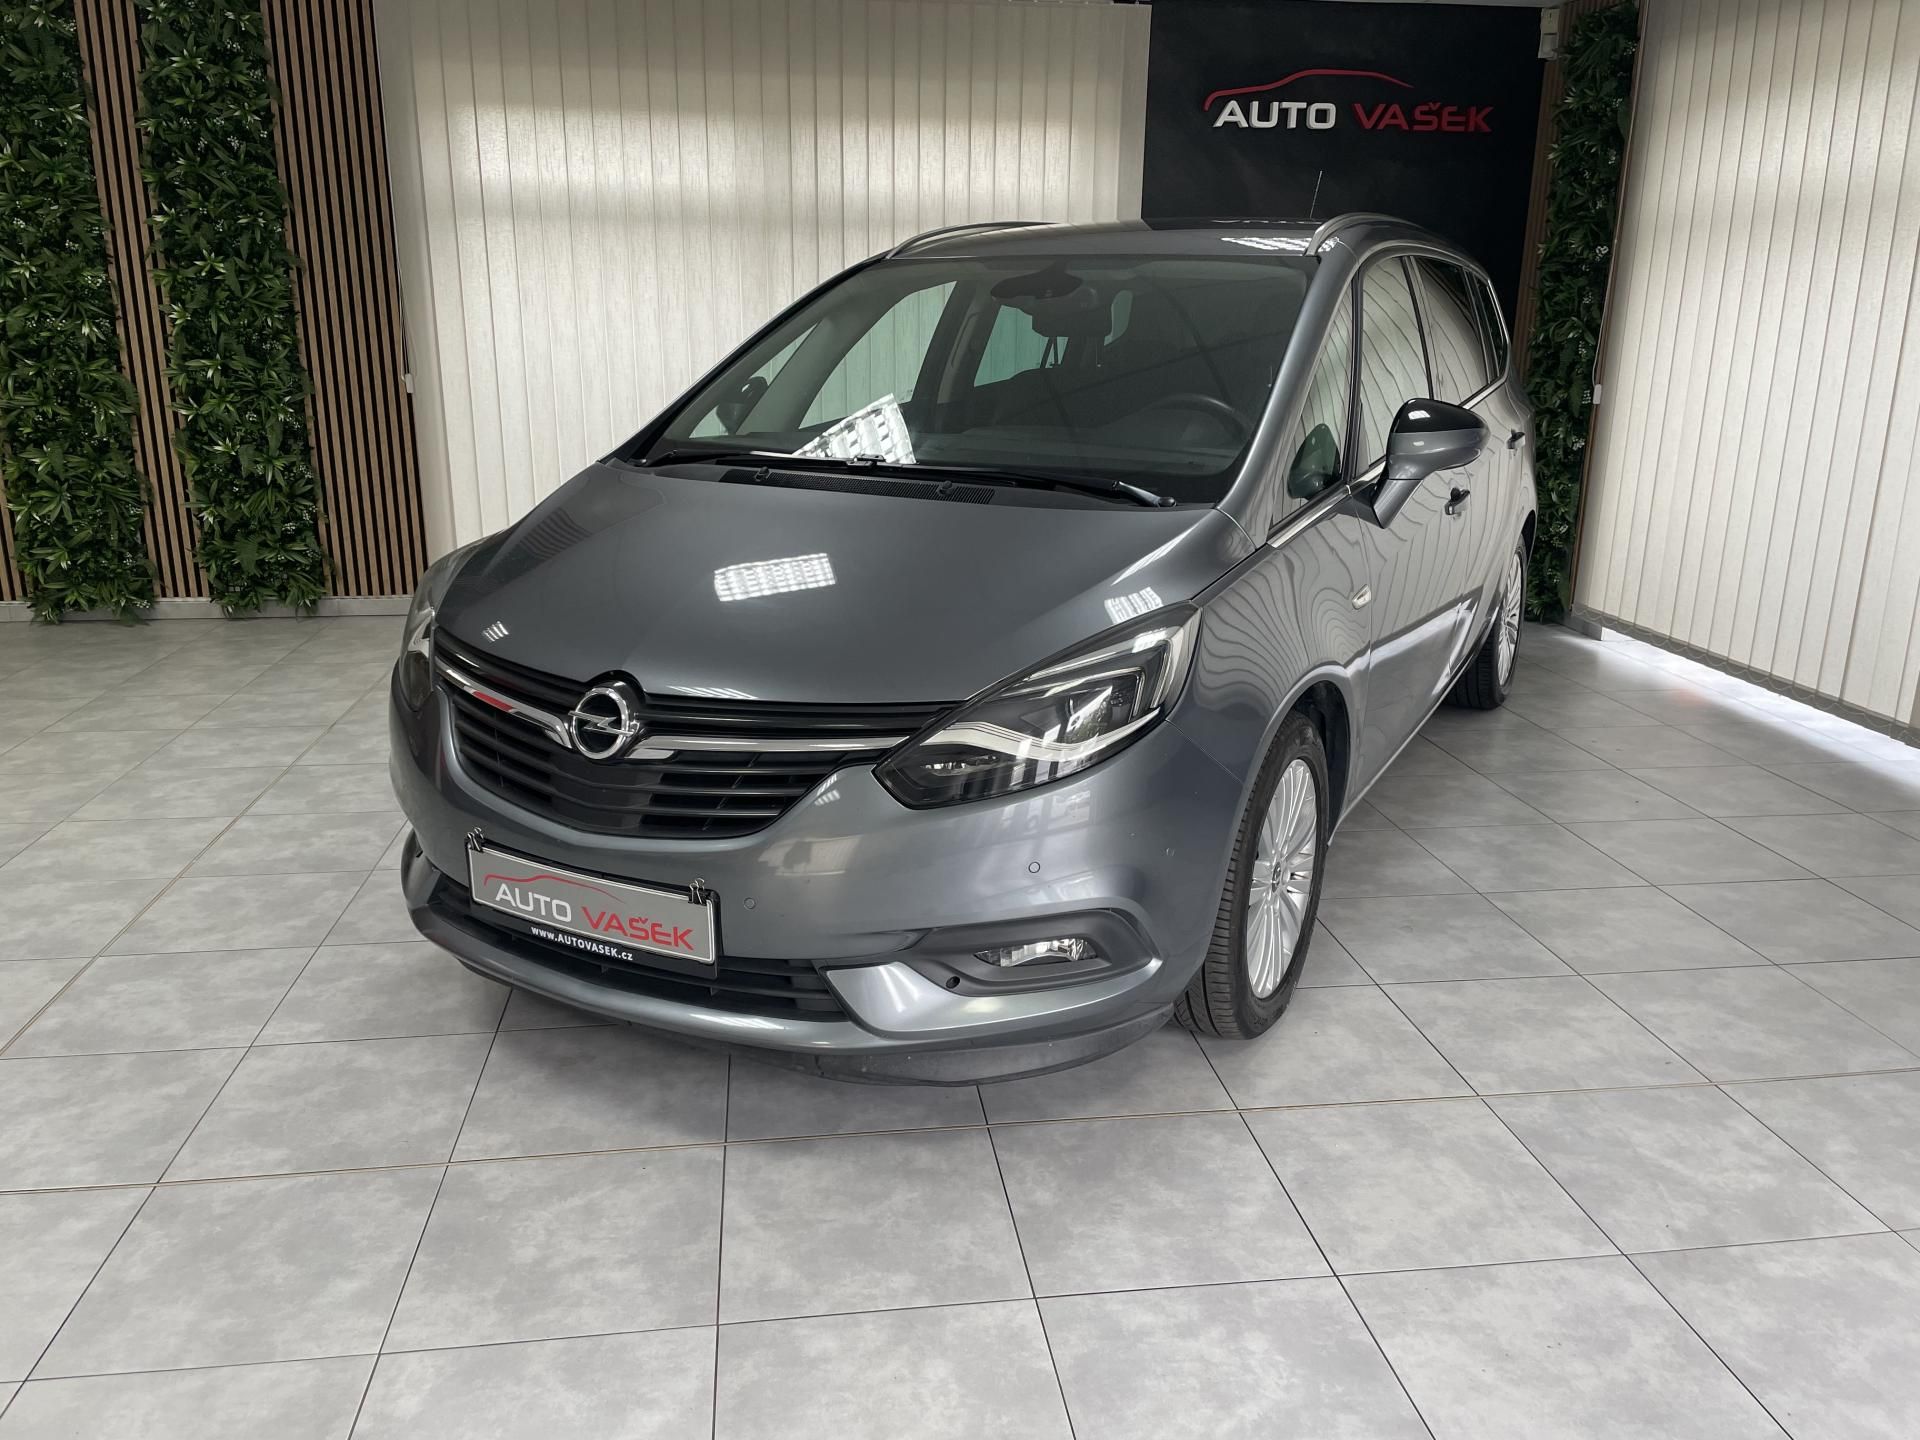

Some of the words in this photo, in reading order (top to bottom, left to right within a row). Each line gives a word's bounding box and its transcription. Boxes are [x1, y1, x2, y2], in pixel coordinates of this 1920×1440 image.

[1213, 100, 1336, 130] AUTO
[1353, 102, 1494, 133] VAŠEK
[495, 883, 572, 923] AUTO
[581, 906, 694, 950] VAŠEK
